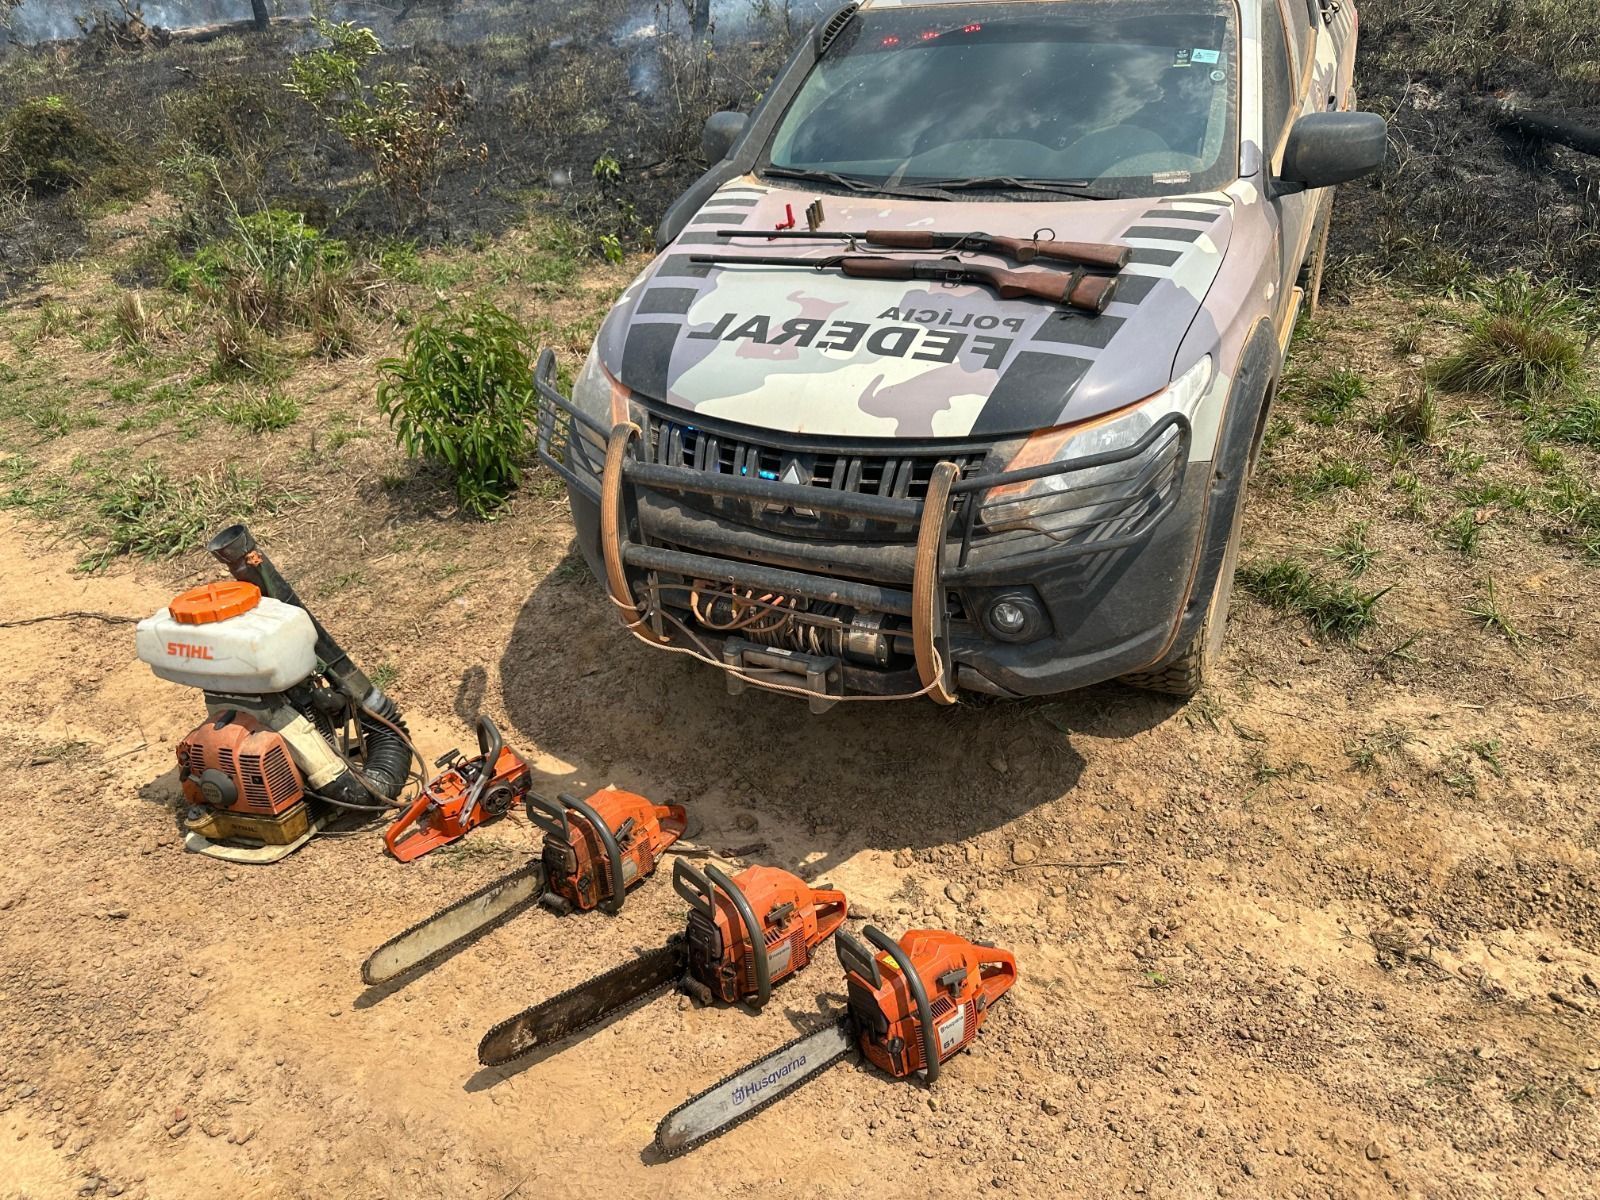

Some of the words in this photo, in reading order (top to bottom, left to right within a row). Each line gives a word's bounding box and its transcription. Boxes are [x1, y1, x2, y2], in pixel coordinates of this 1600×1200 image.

[167, 642, 213, 660] STIHL
[943, 1037, 955, 1049] 61
[745, 1055, 807, 1097] Husqvarna
